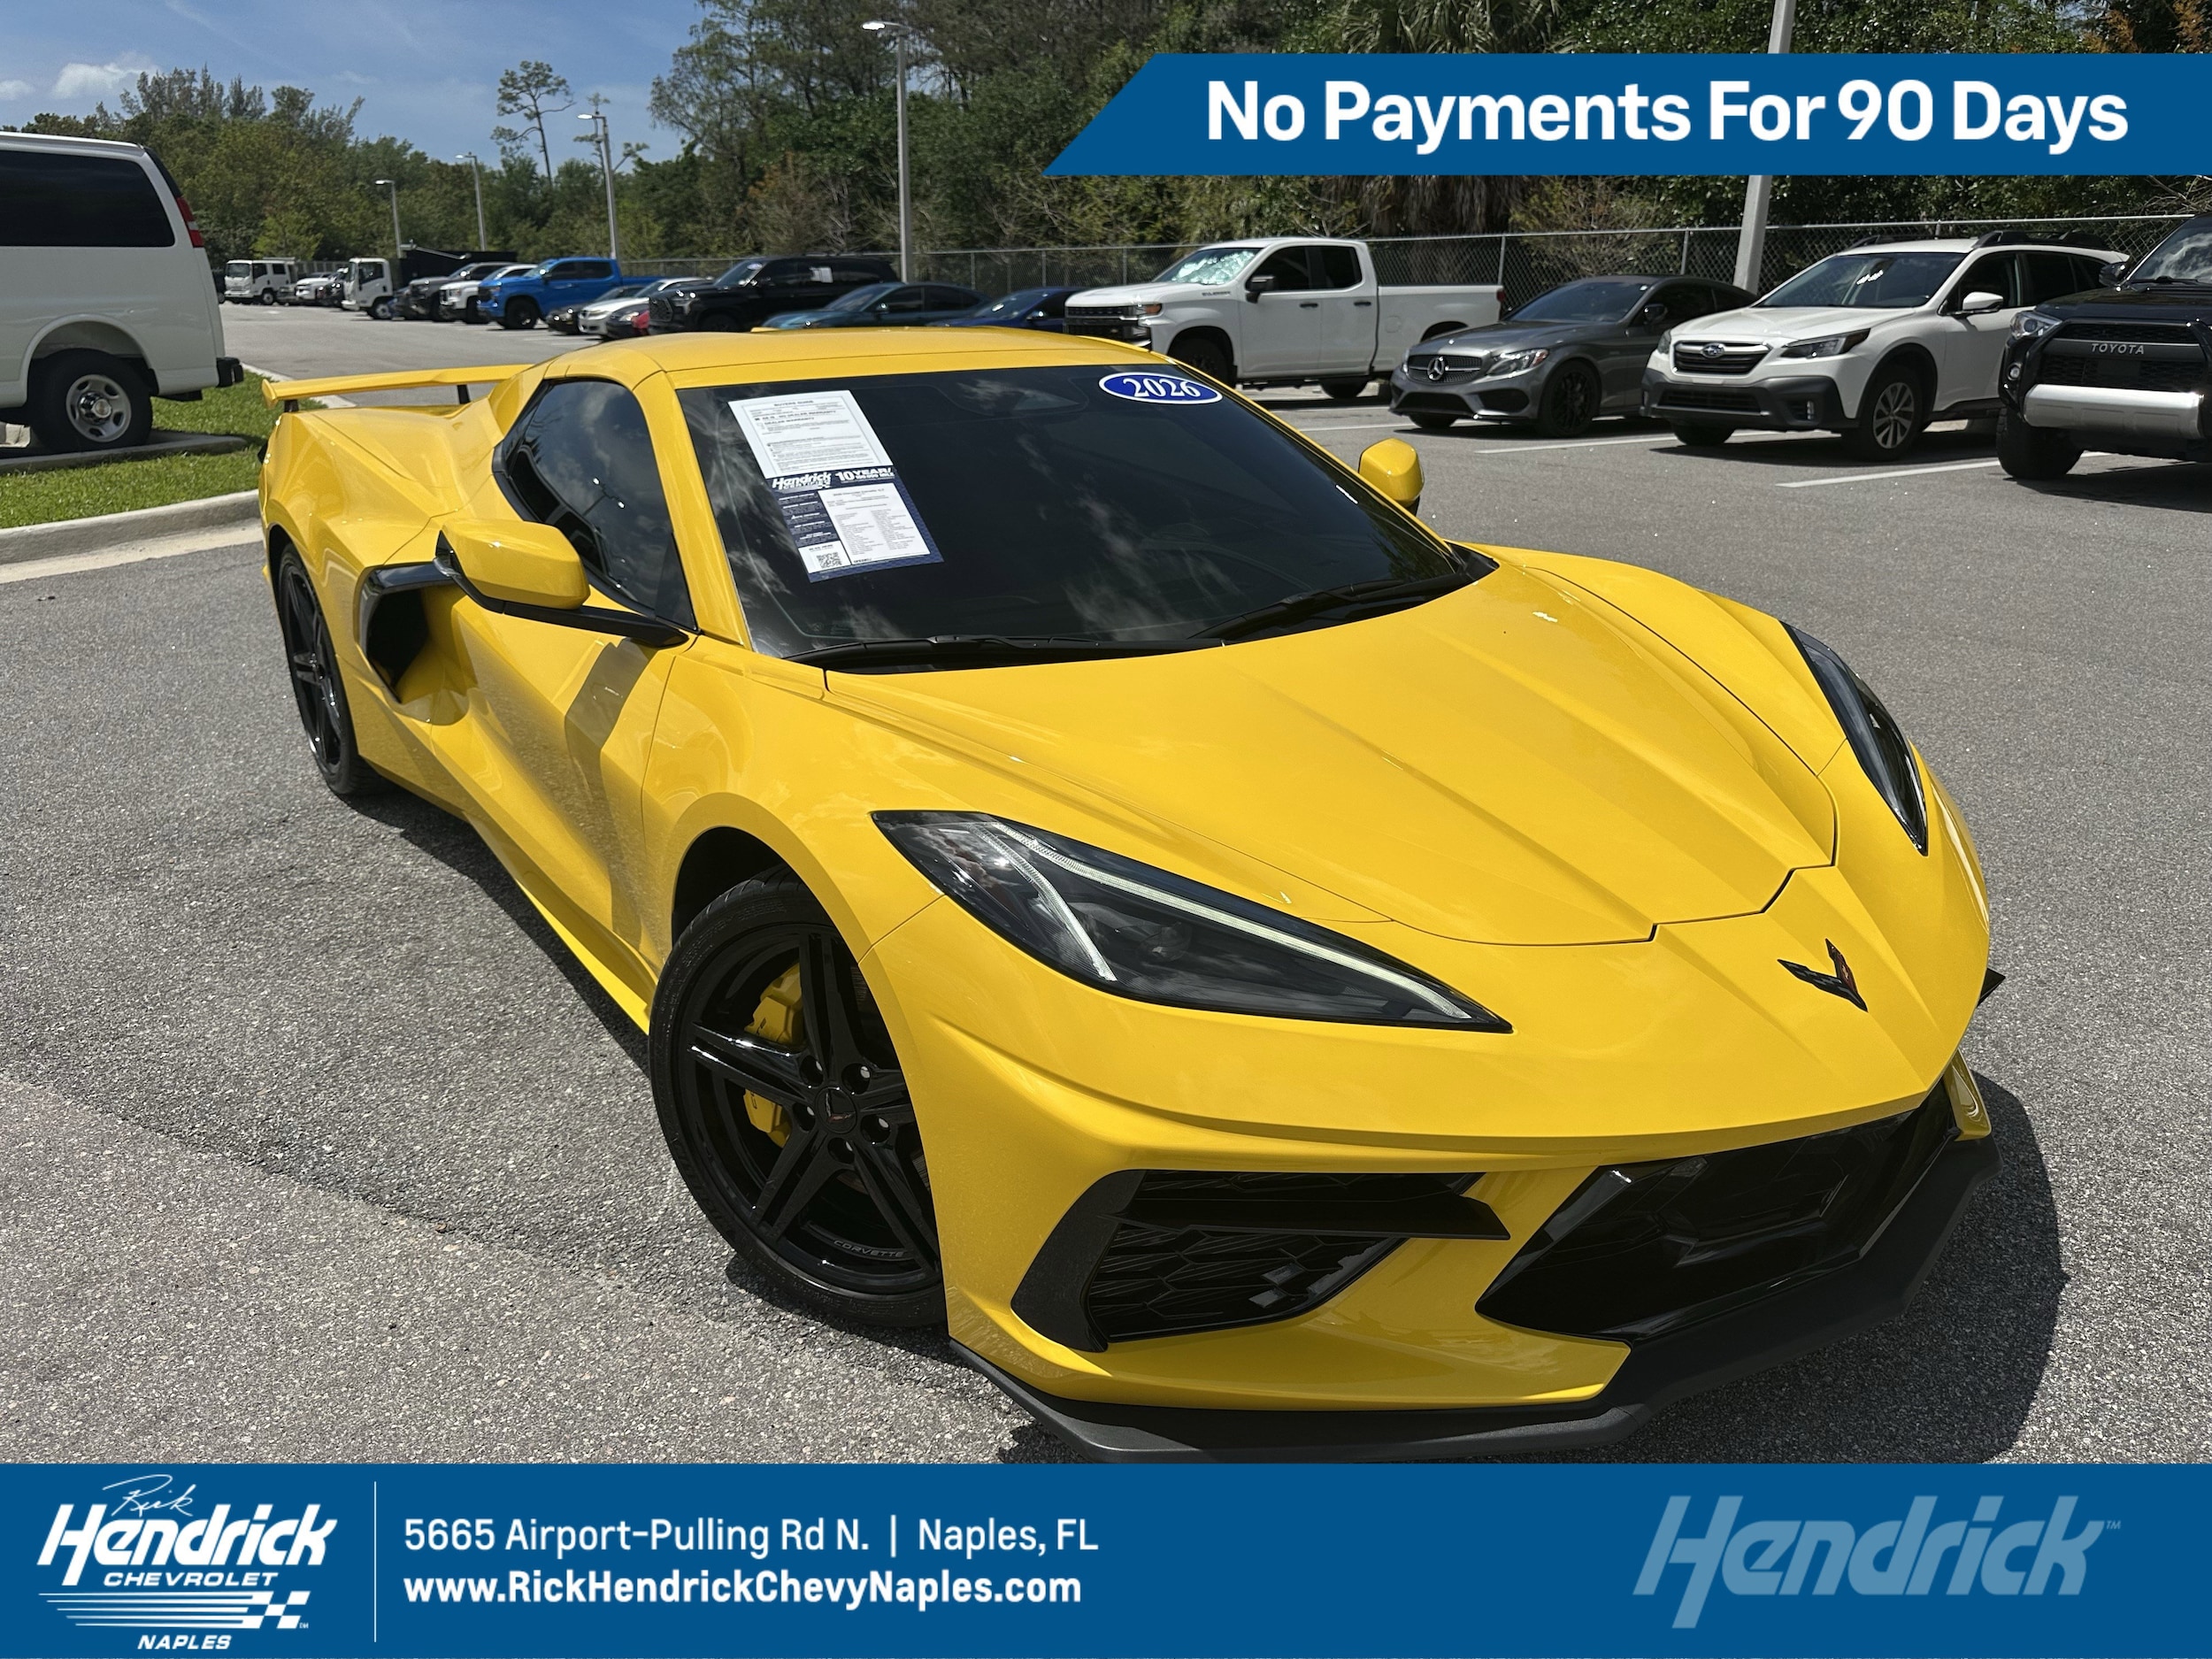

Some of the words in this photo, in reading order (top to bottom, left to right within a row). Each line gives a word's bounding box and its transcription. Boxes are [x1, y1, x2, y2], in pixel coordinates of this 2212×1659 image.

[2091, 342, 2145, 355] TOYOTA
[1122, 378, 1202, 397] 2026
[772, 472, 832, 490] Hendrick
[834, 471, 855, 481] 10
[833, 1240, 903, 1257] CORVETTE
